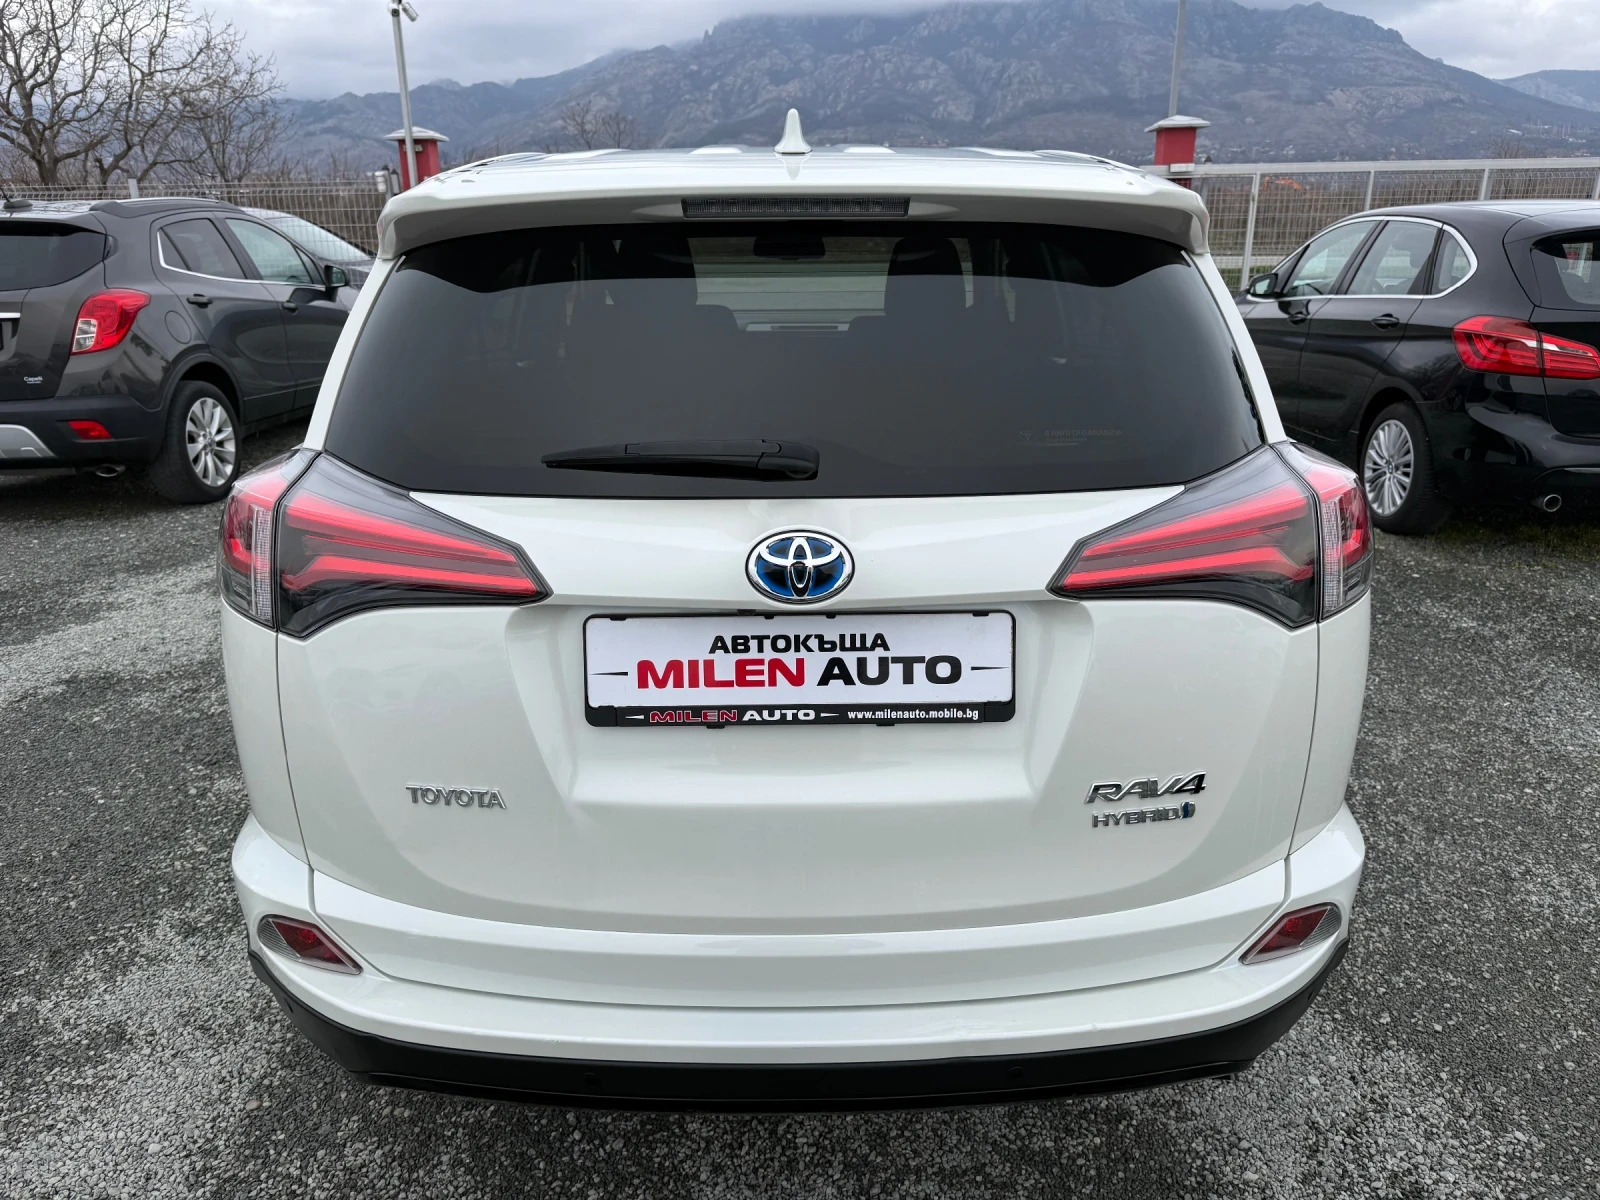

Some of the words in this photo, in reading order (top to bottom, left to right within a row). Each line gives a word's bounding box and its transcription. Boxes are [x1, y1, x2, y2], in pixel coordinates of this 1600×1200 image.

[708, 633, 890, 654] АВТОКЪЩА
[636, 658, 805, 689] MILEN
[816, 655, 962, 687] AUTO
[649, 709, 738, 723] MILEN
[741, 709, 816, 722] AUTO
[847, 709, 980, 721] www.milenauto.mobile.bg
[405, 784, 507, 809] TOYOTA
[1084, 770, 1206, 803] RAV4
[1092, 805, 1180, 827] HYBRID
